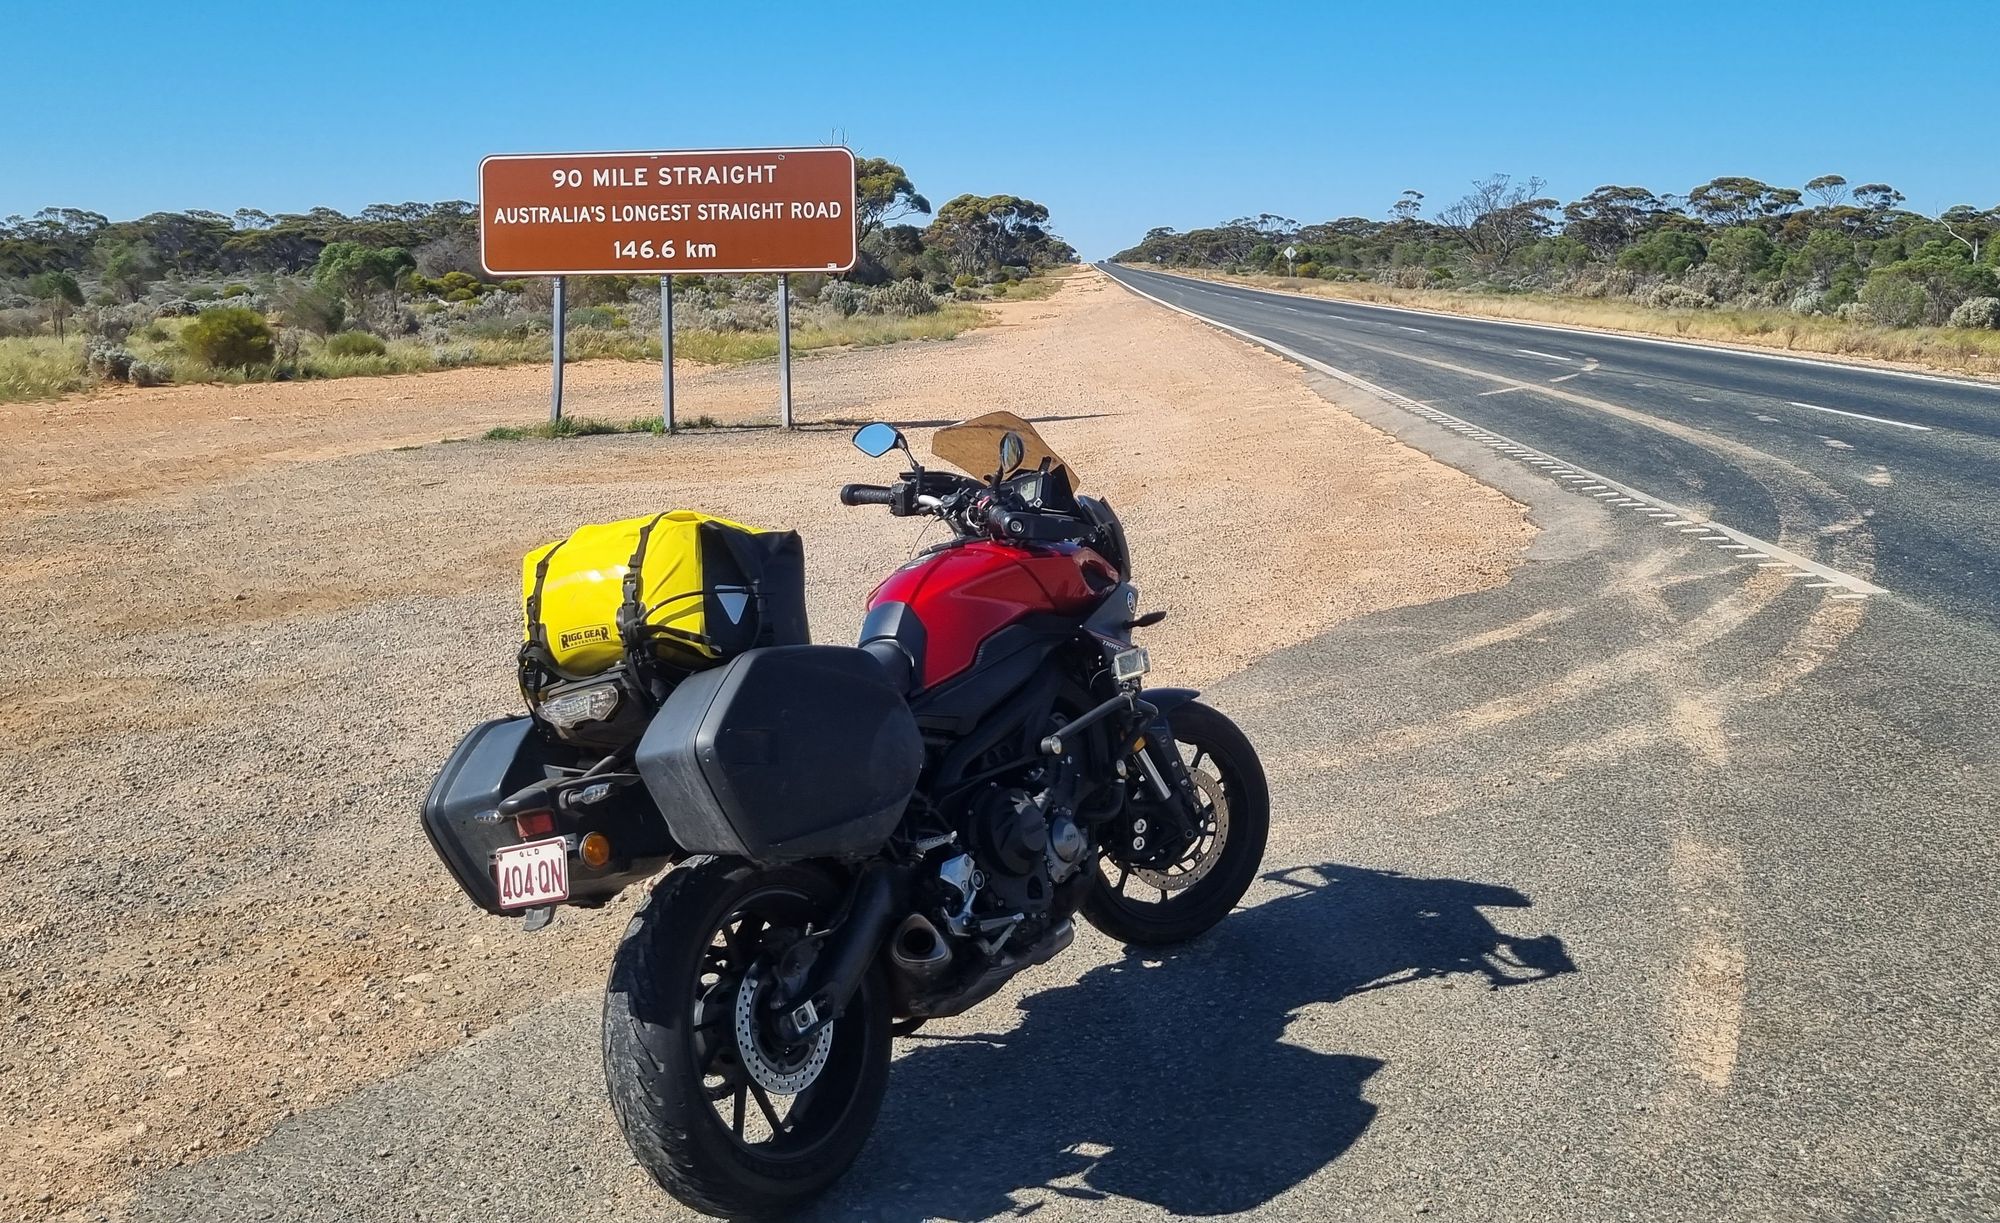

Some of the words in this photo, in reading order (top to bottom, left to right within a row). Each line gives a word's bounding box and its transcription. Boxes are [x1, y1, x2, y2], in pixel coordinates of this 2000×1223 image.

[552, 169, 583, 188] 90
[593, 167, 648, 187] MILE
[658, 164, 778, 186] STRAIGHT
[493, 205, 606, 225] AUSTRALIA'S
[612, 204, 692, 222] LONGEST
[697, 202, 785, 221] STRAIGHT
[791, 201, 841, 219] ROAD
[613, 240, 676, 259] 146.6
[686, 239, 716, 258] km
[561, 633, 583, 649] RIGG
[584, 626, 610, 641] GEAR
